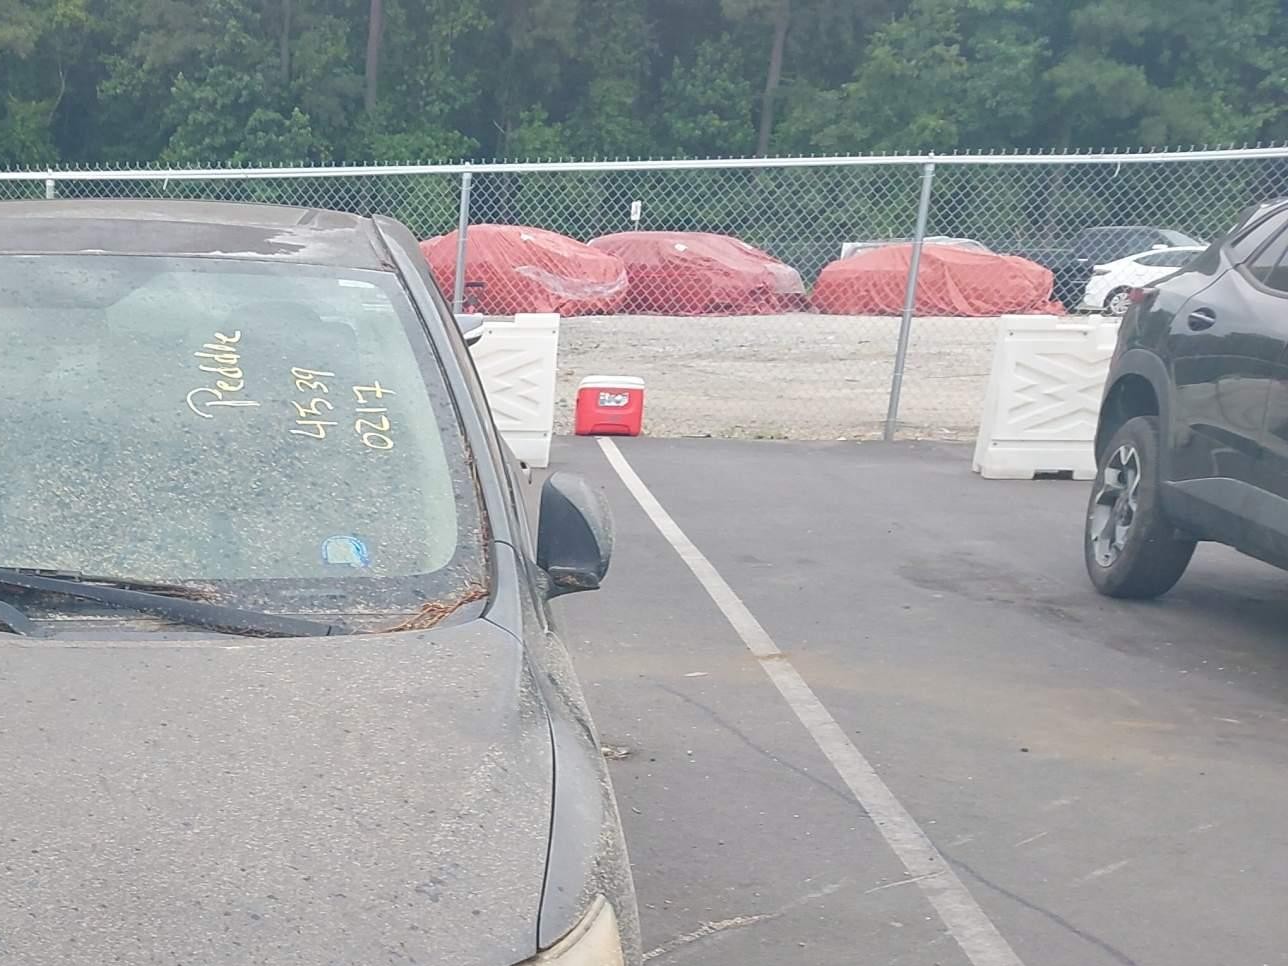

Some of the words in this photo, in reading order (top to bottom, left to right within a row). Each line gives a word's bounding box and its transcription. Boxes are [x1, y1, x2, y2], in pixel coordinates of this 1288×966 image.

[186, 330, 261, 418] Peddle
[289, 366, 339, 439] 4539
[351, 380, 397, 450] 0217
